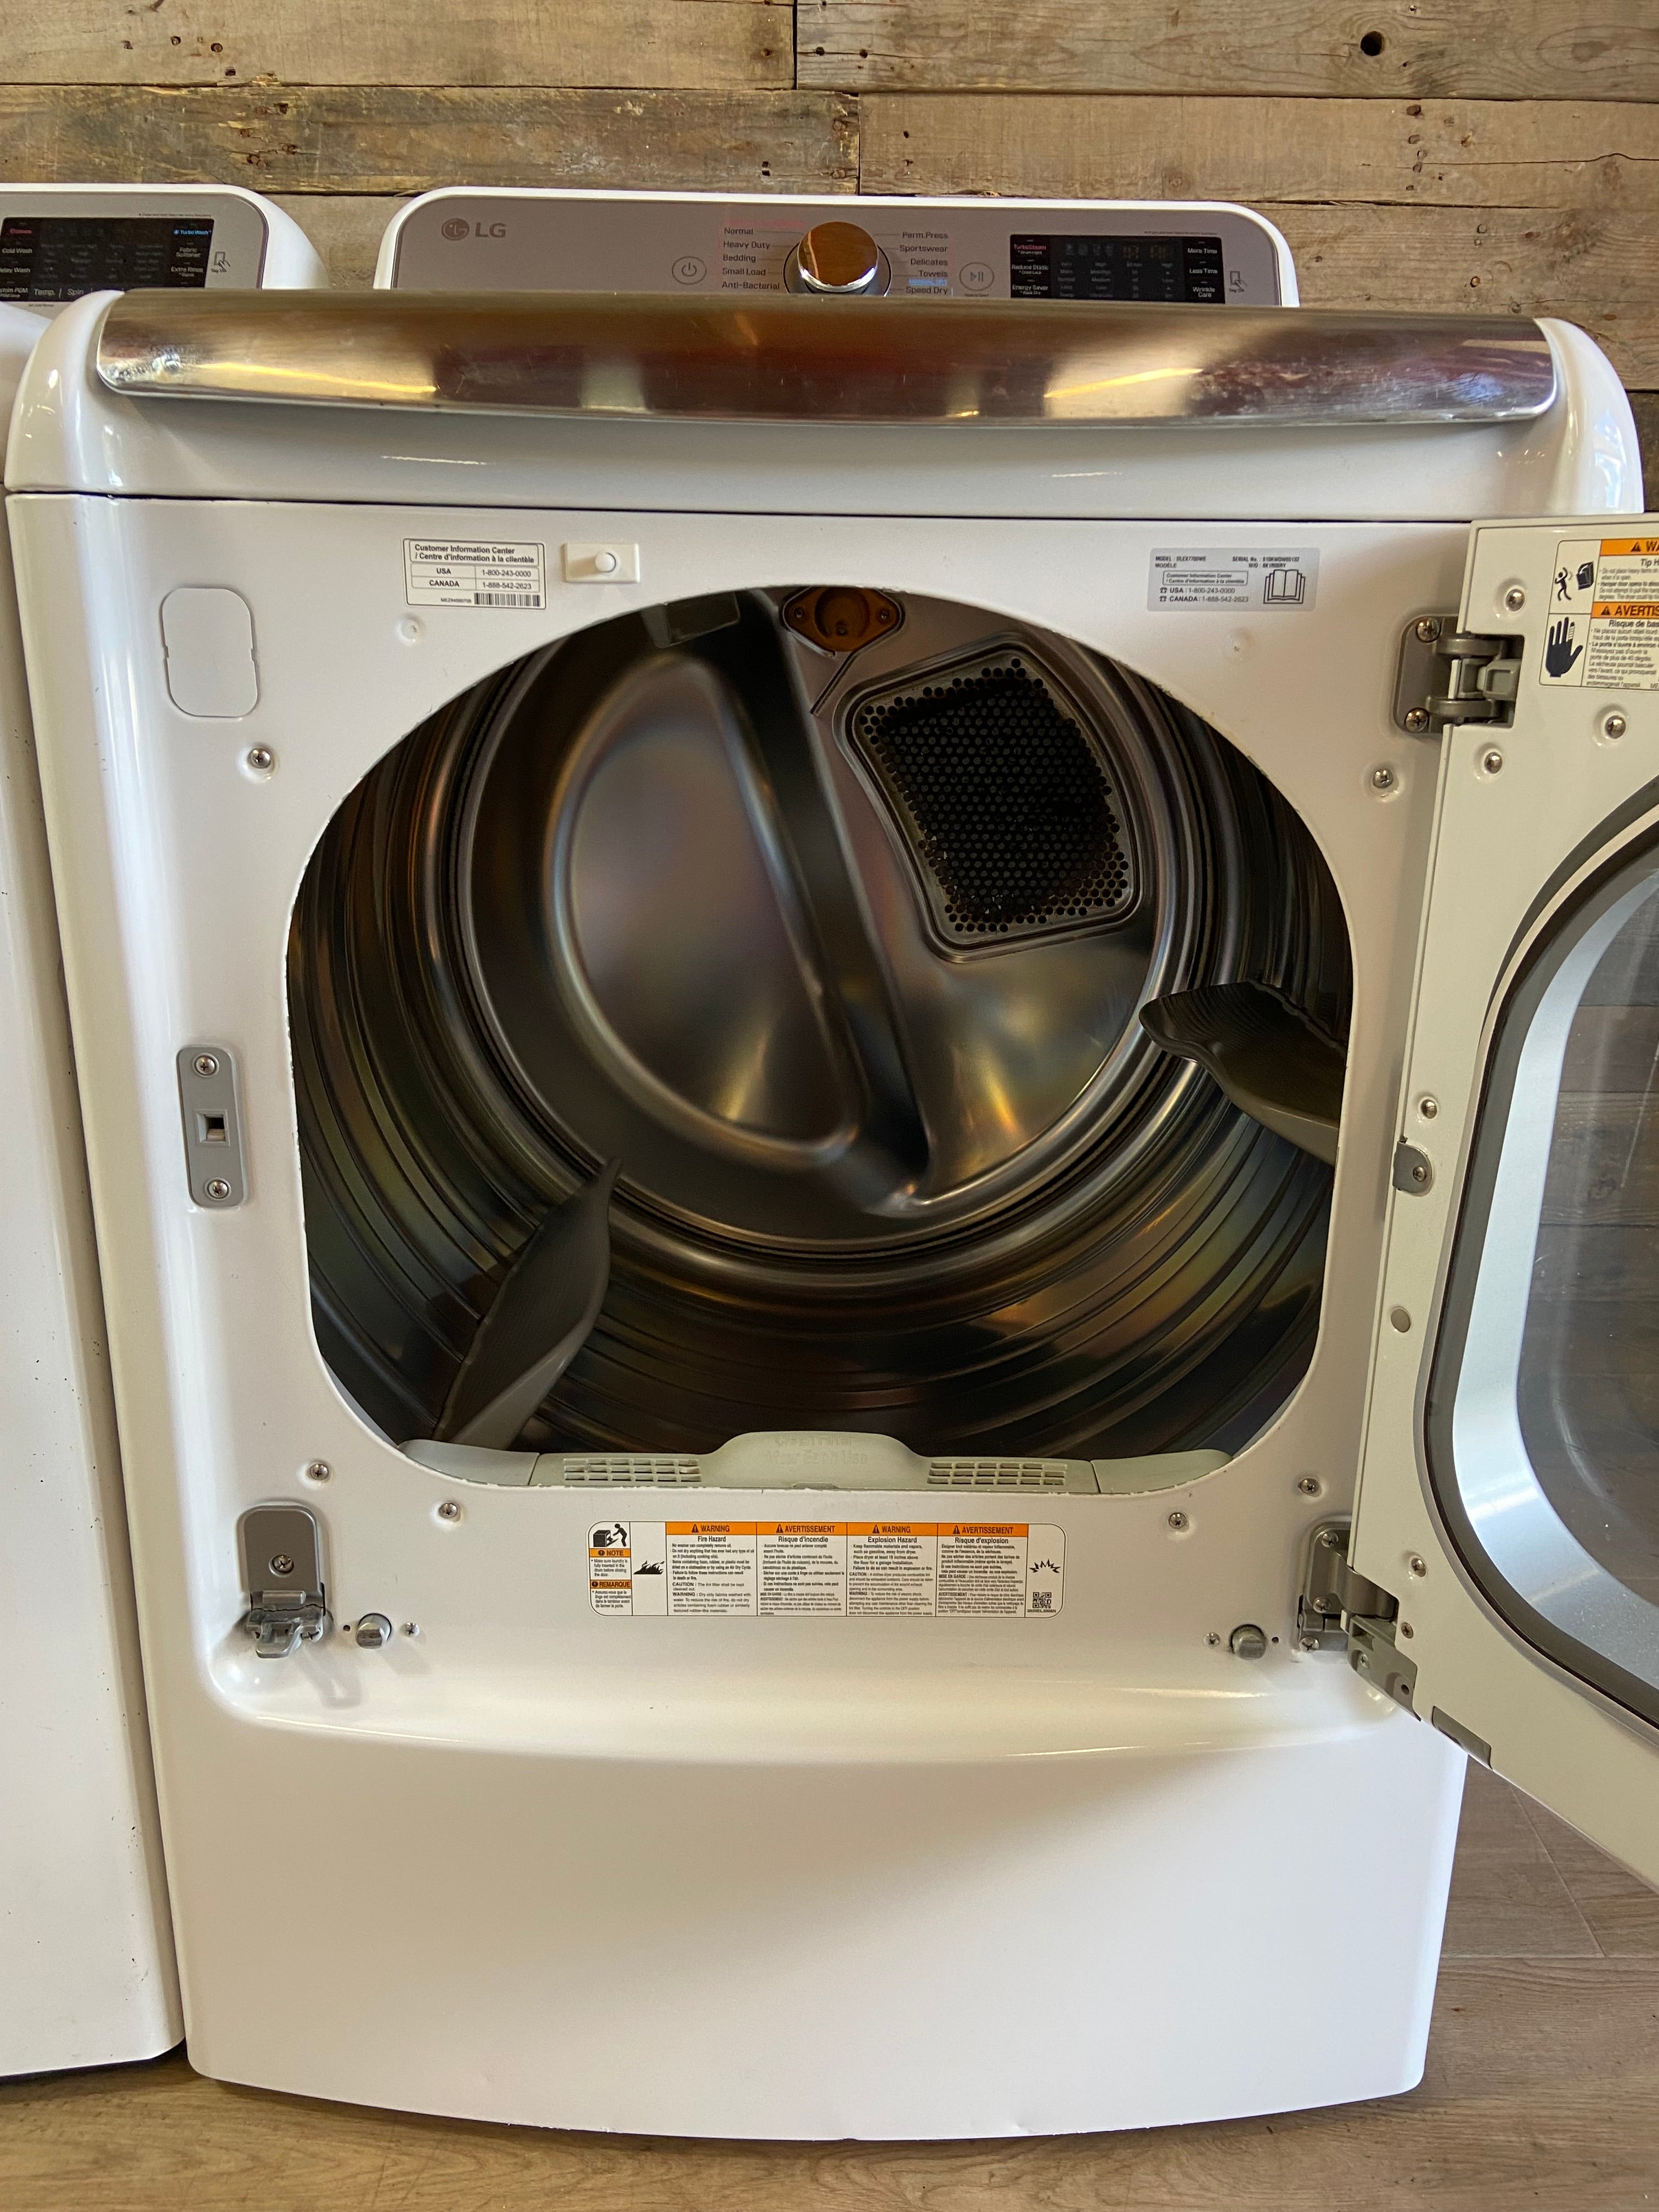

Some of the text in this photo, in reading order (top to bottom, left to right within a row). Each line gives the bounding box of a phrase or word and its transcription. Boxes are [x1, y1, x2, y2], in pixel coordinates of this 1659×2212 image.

[475, 222, 506, 238] LG
[723, 241, 770, 250] Heavy Duty
[900, 245, 948, 253] Sportswear
[723, 255, 756, 263] Bedding
[722, 281, 780, 290] Anti-Bacterial
[1641, 558, 1652, 568] Tip
[1609, 620, 1634, 629] Risque
